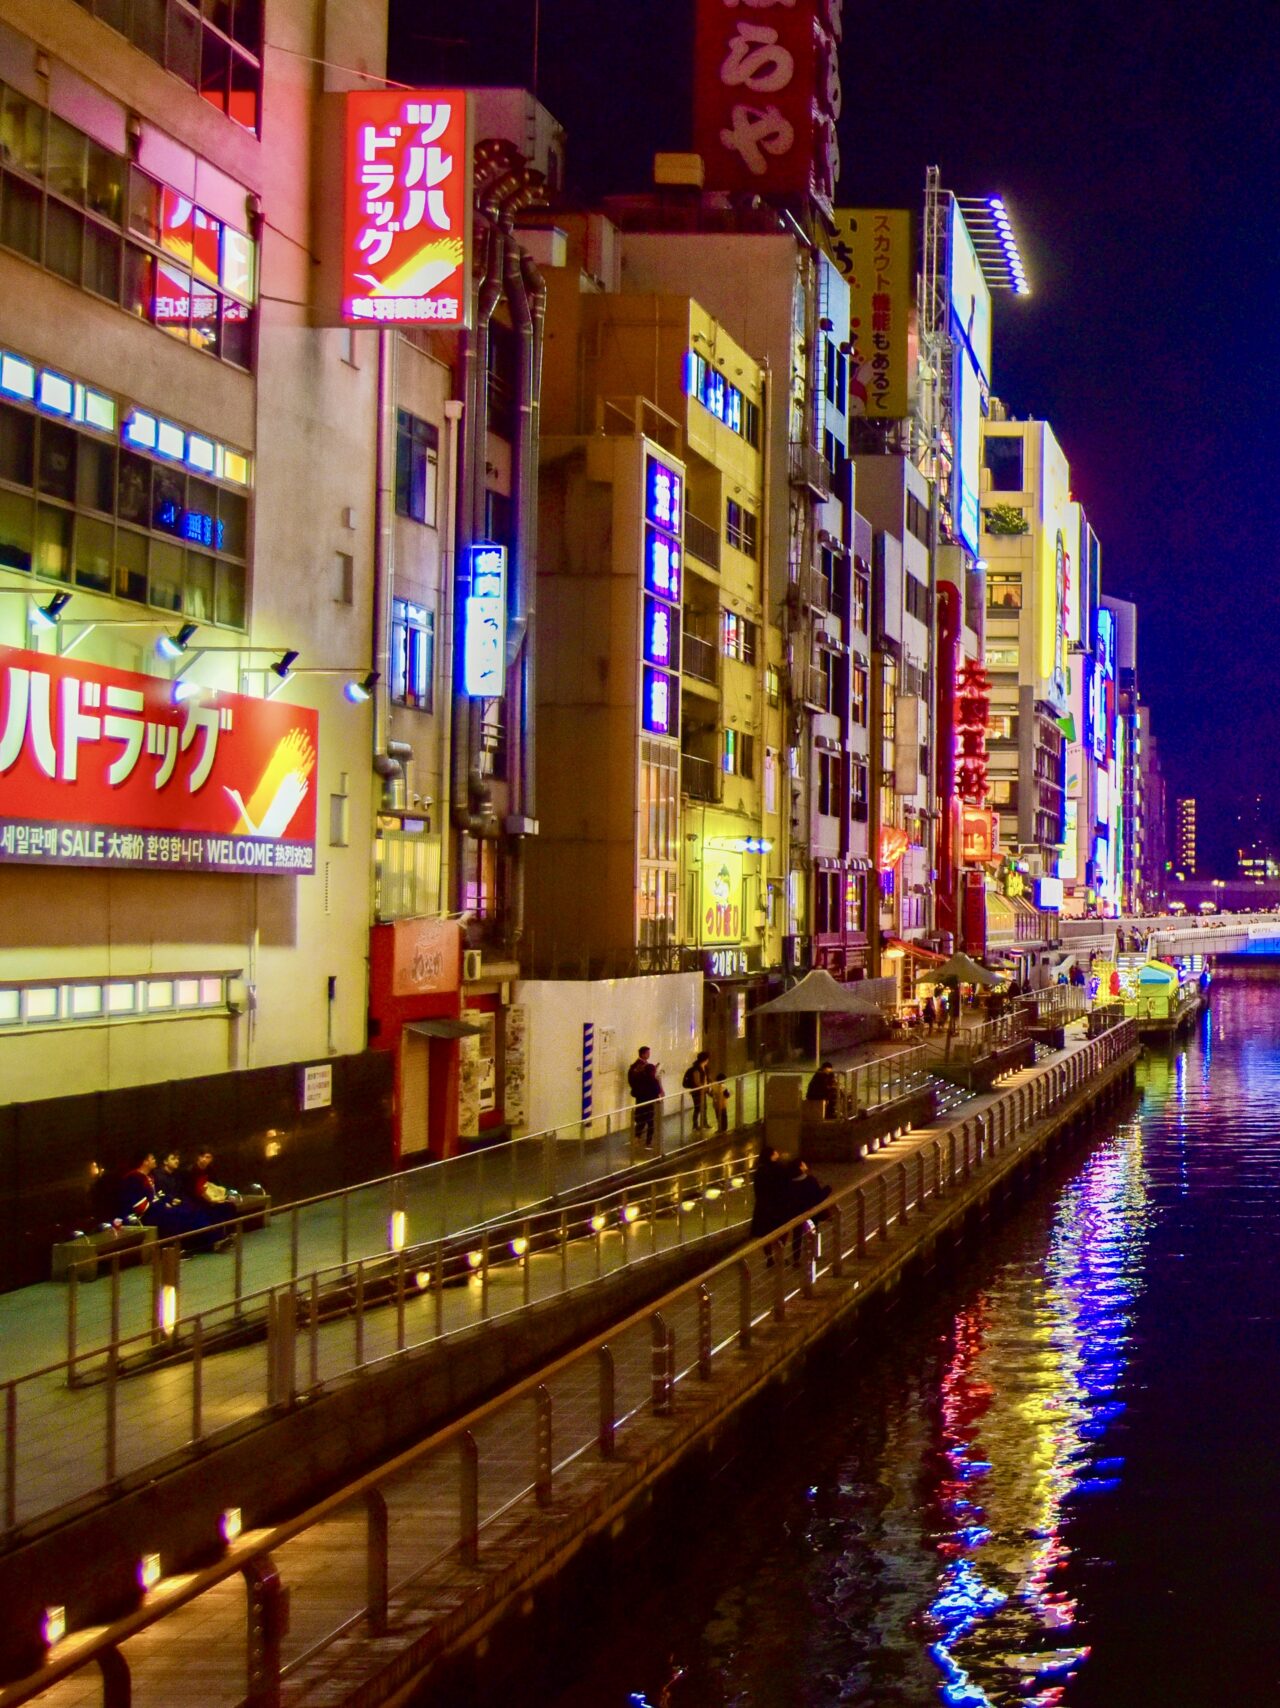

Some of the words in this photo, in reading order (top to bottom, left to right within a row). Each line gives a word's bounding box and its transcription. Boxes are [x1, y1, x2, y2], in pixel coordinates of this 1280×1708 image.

[720, 0, 797, 175] らや
[360, 126, 401, 265] ドラッグ
[403, 104, 452, 230] ツルハ
[0, 667, 233, 793] ハドラッグ
[1, 825, 57, 854] 세일판매
[61, 829, 104, 858] SALE
[147, 836, 203, 863] 환영합니다
[207, 839, 273, 867] WELCOME
